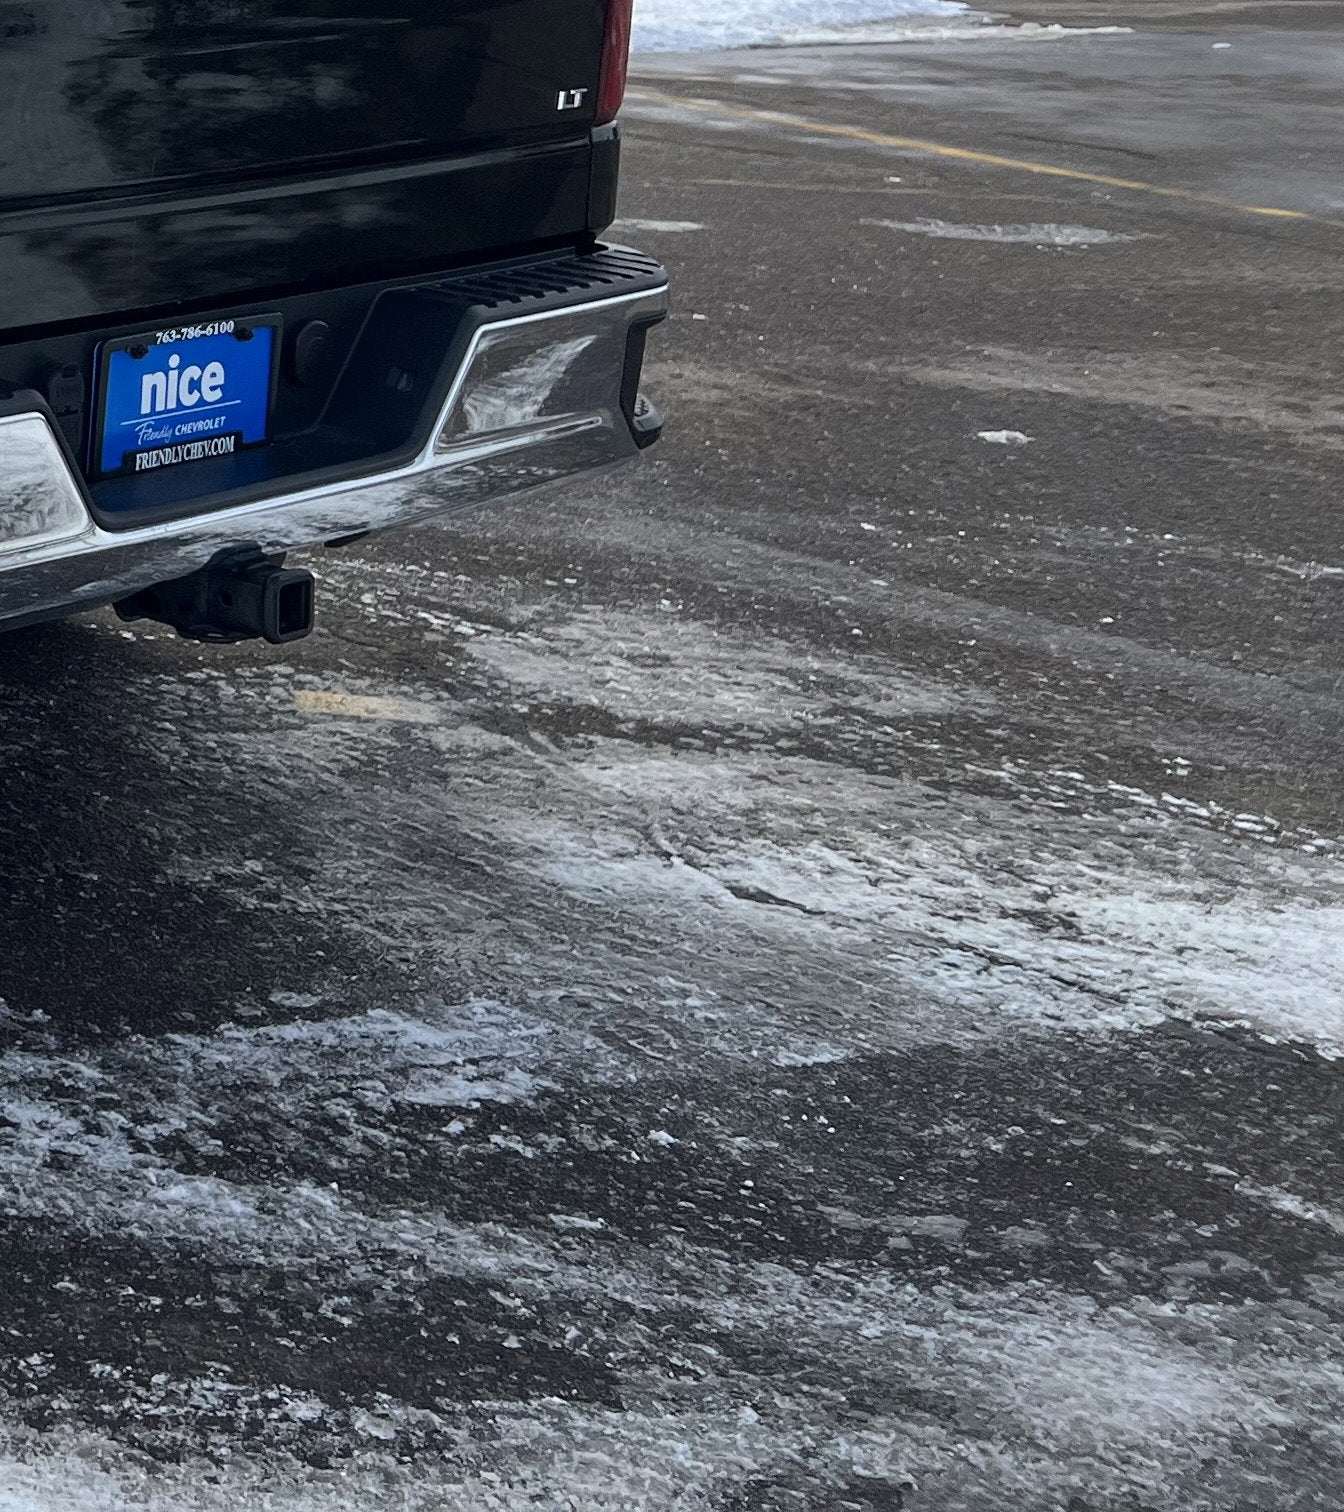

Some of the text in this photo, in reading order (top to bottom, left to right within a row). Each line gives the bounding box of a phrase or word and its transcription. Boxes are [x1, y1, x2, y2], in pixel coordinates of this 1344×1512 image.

[557, 88, 588, 111] LT
[155, 320, 236, 345] 763-786-6100
[140, 353, 226, 415] nice
[134, 416, 227, 446] Friendly CHEVROLET
[135, 436, 236, 471] FRIENDLYCHEV.COM
